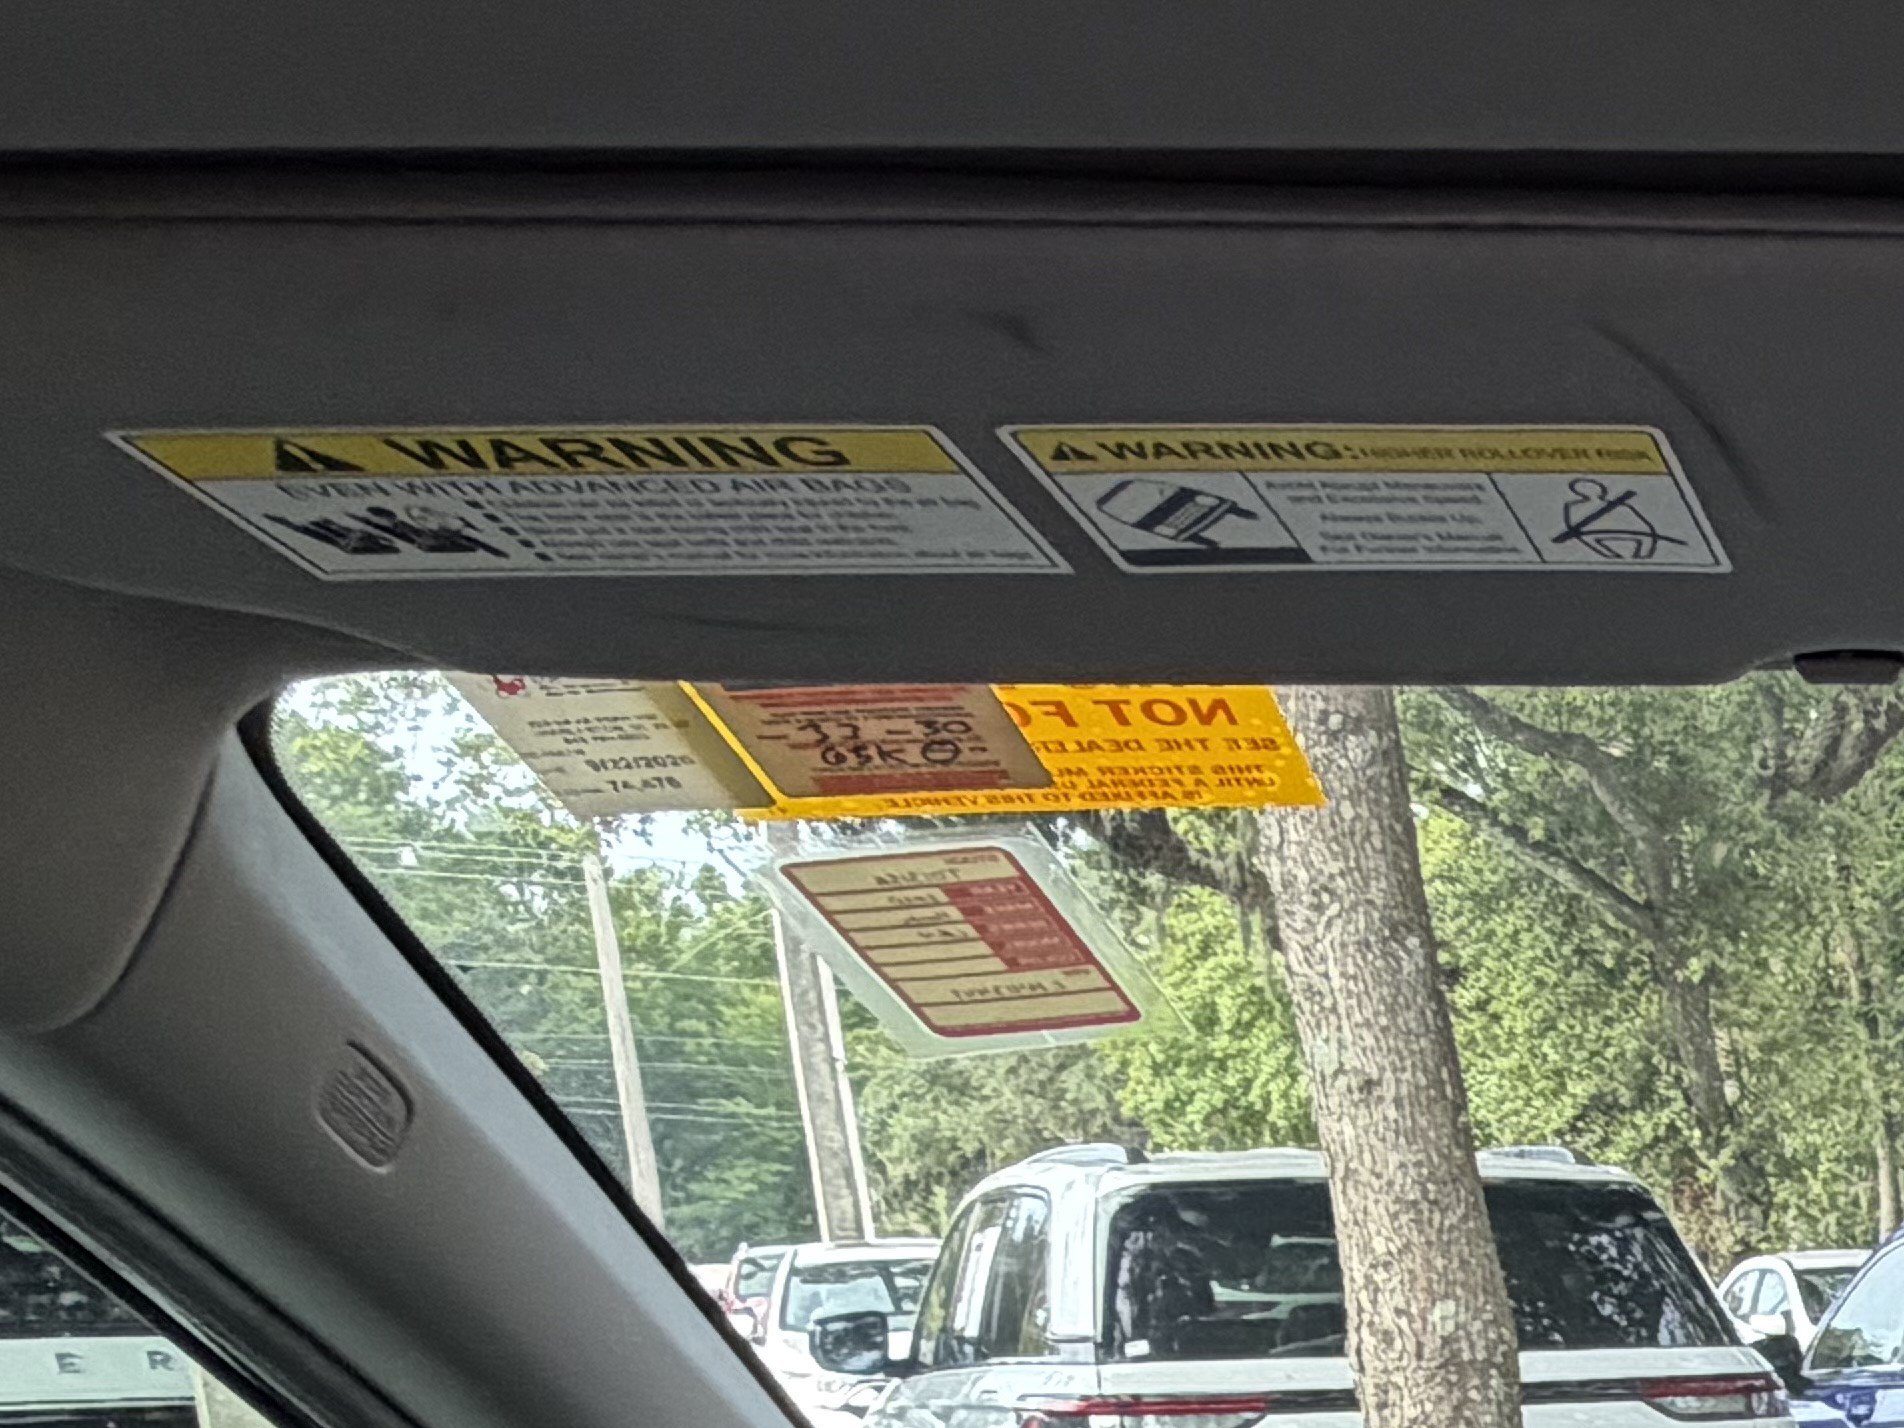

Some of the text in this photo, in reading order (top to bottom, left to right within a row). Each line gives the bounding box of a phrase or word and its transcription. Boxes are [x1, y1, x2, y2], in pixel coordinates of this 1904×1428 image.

[383, 436, 851, 471] WARNING
[1095, 440, 1358, 461] WARNING:
[276, 480, 392, 499] EVEN
[399, 479, 501, 498] WITH
[508, 478, 722, 497] ADVANCED
[729, 478, 789, 495] AIR
